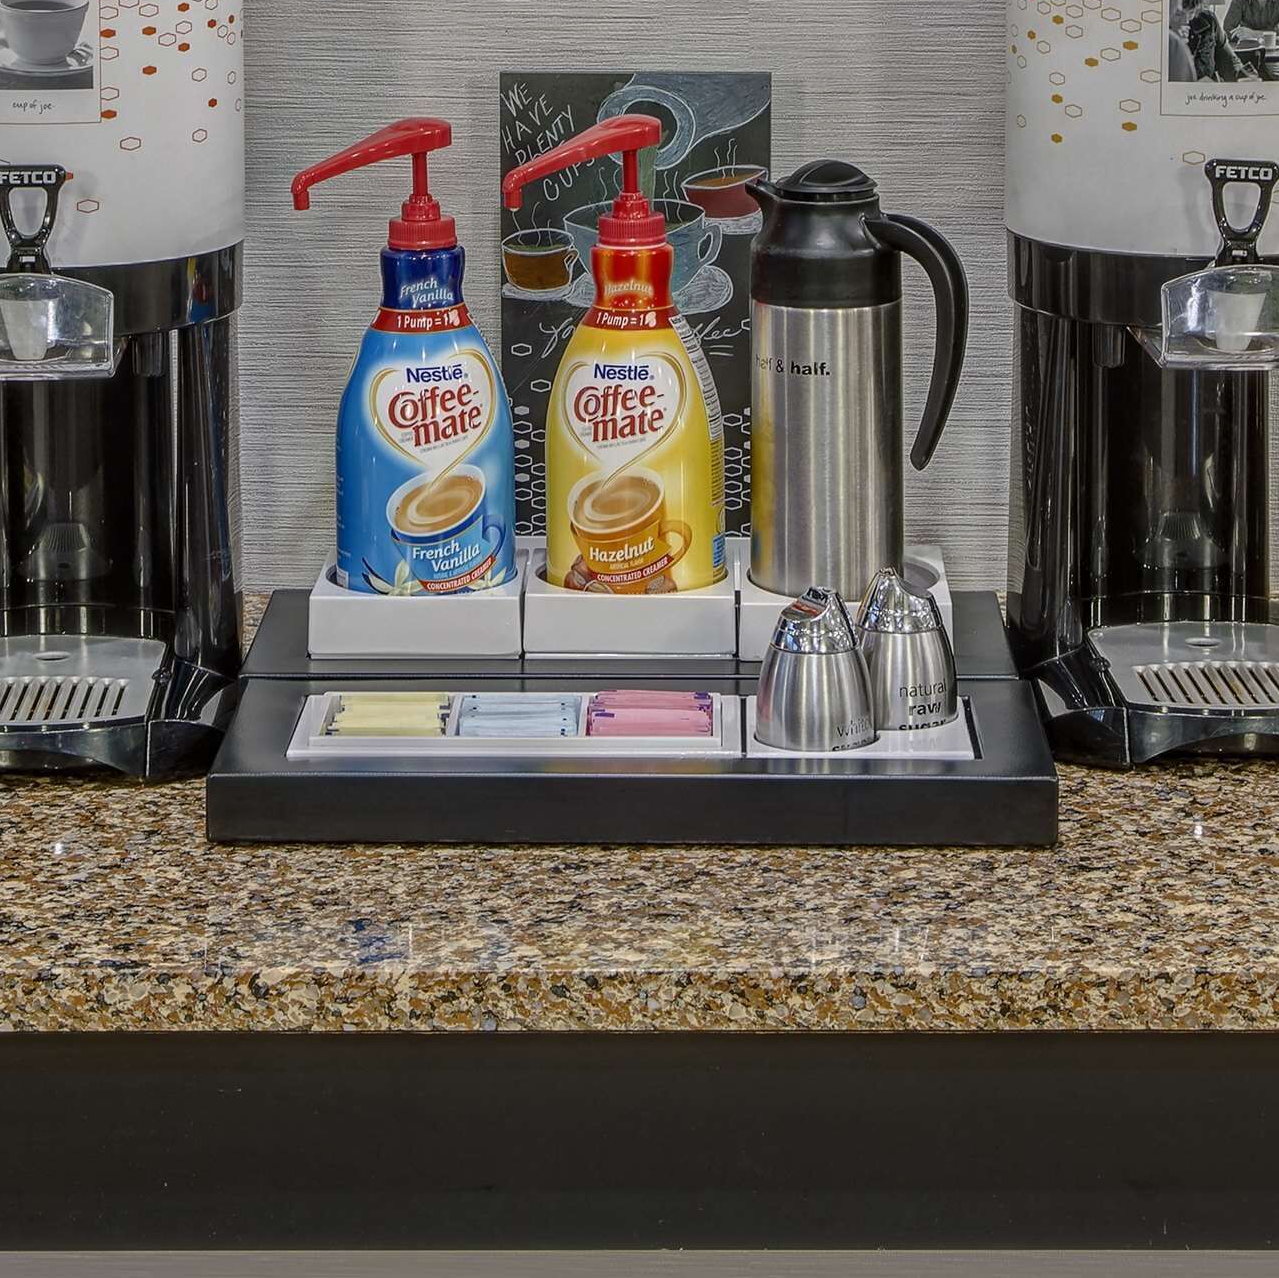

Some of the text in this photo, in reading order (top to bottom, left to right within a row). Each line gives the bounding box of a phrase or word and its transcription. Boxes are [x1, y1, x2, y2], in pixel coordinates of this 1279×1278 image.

[500, 82, 533, 117] WE
[501, 93, 554, 154] HAVE
[1215, 165, 1273, 180] FETCO
[400, 277, 438, 299] French
[412, 288, 454, 309] Vanilla
[404, 316, 433, 330] Pump
[601, 312, 629, 329] Pump
[776, 358, 784, 373] &
[790, 360, 830, 376] half.
[412, 405, 482, 447] mate
[592, 408, 664, 443] mate
[412, 540, 461, 560] French
[431, 543, 481, 572] Vanilla
[589, 536, 655, 562] Hazelnut
[597, 556, 669, 582] CONCENTRATED CREAMER
[426, 575, 471, 591] CONCENTRATED
[899, 679, 947, 698] natural
[909, 702, 942, 716] raw
